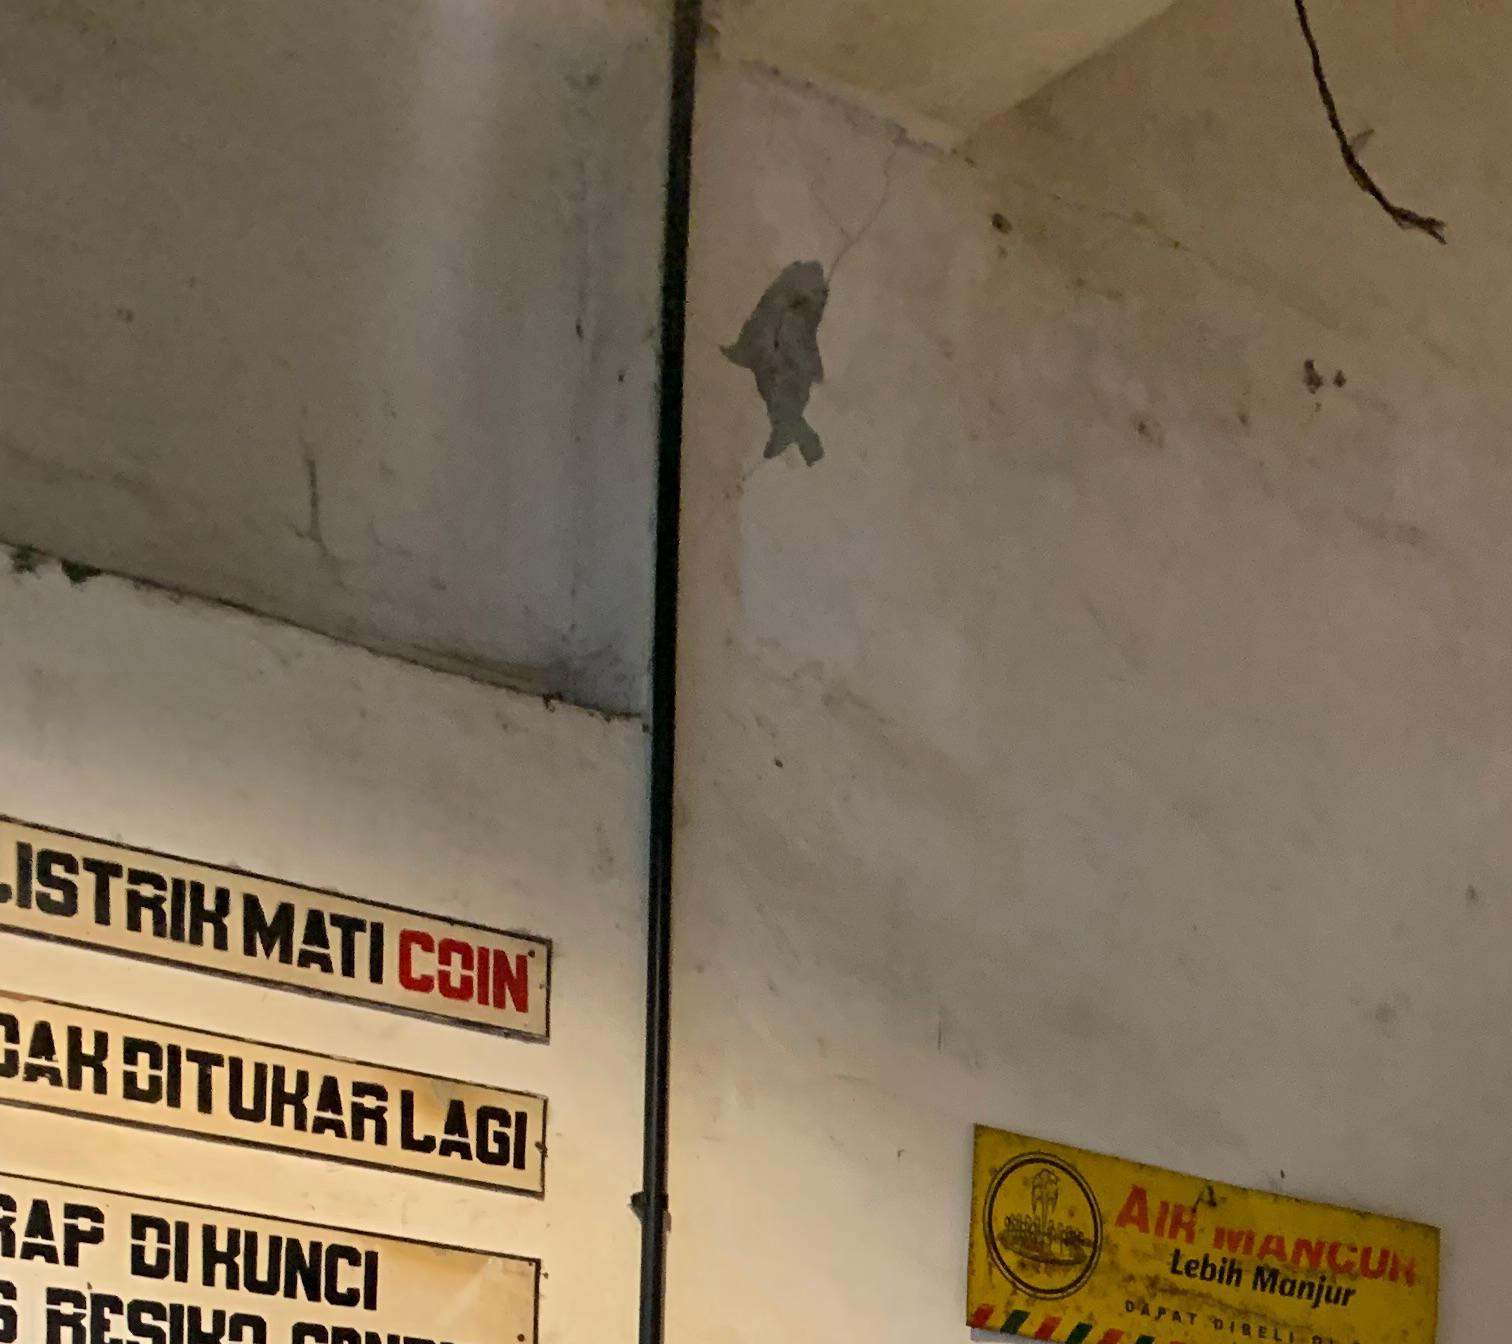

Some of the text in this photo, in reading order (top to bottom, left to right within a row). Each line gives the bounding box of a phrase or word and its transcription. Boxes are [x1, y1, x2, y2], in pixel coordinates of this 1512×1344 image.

[0, 841, 529, 1013] ISTRIK MATI COIN
[122, 1035, 389, 1147] DITUKAR
[400, 1089, 528, 1170] LAGI
[1115, 1183, 1197, 1245] AIR
[1170, 1248, 1357, 1310] Lebih Manjur
[1125, 1300, 1199, 1326] DAPAT
[1213, 1317, 1295, 1344] DIBELI
